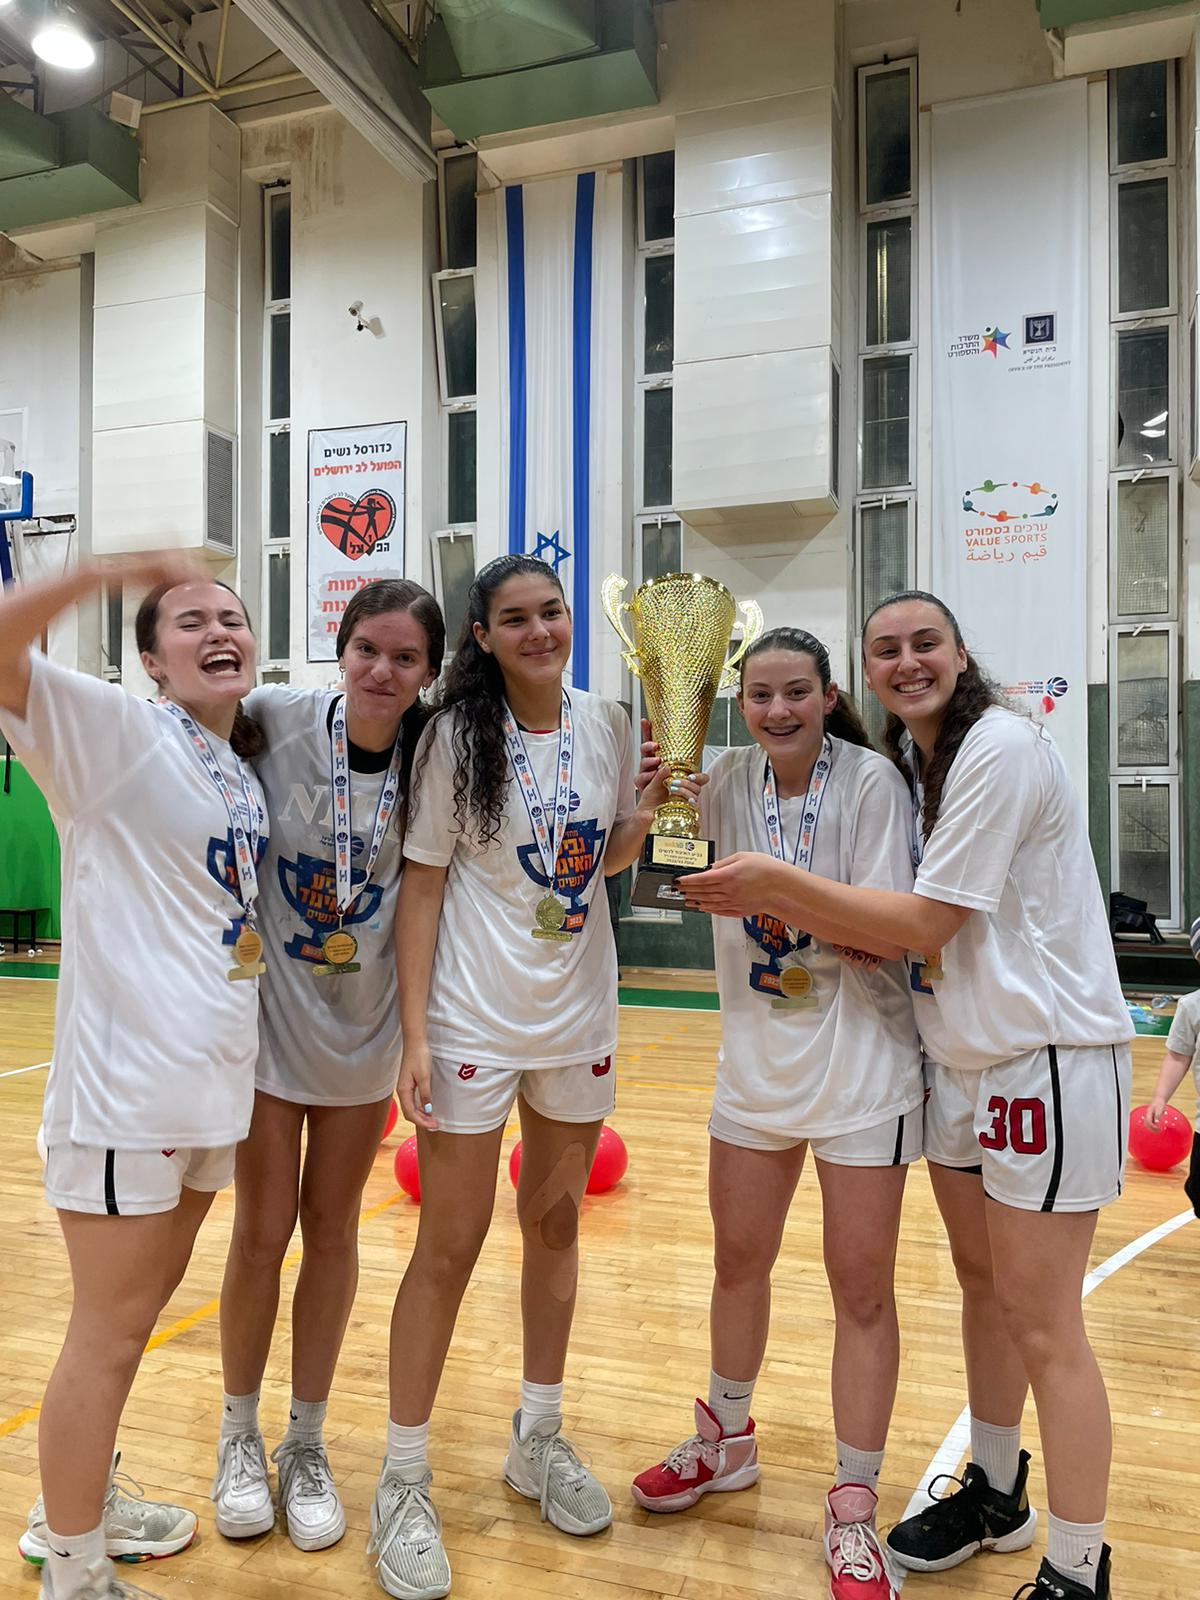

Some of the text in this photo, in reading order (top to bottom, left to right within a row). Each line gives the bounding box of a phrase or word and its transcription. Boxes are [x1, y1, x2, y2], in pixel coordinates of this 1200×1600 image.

[958, 334, 980, 342] משרד
[947, 348, 980, 358] והספורט
[950, 341, 980, 351] התרבות
[323, 443, 392, 458] כדורסל נשים
[313, 460, 402, 477] הפועל לב ירושלים
[965, 523, 1048, 537] ערכים בספורט
[965, 533, 1048, 547] VALUE SPORTS
[966, 545, 1047, 564] قيم رياضة
[556, 853, 593, 875] האיגו
[978, 1095, 1047, 1156] 30
